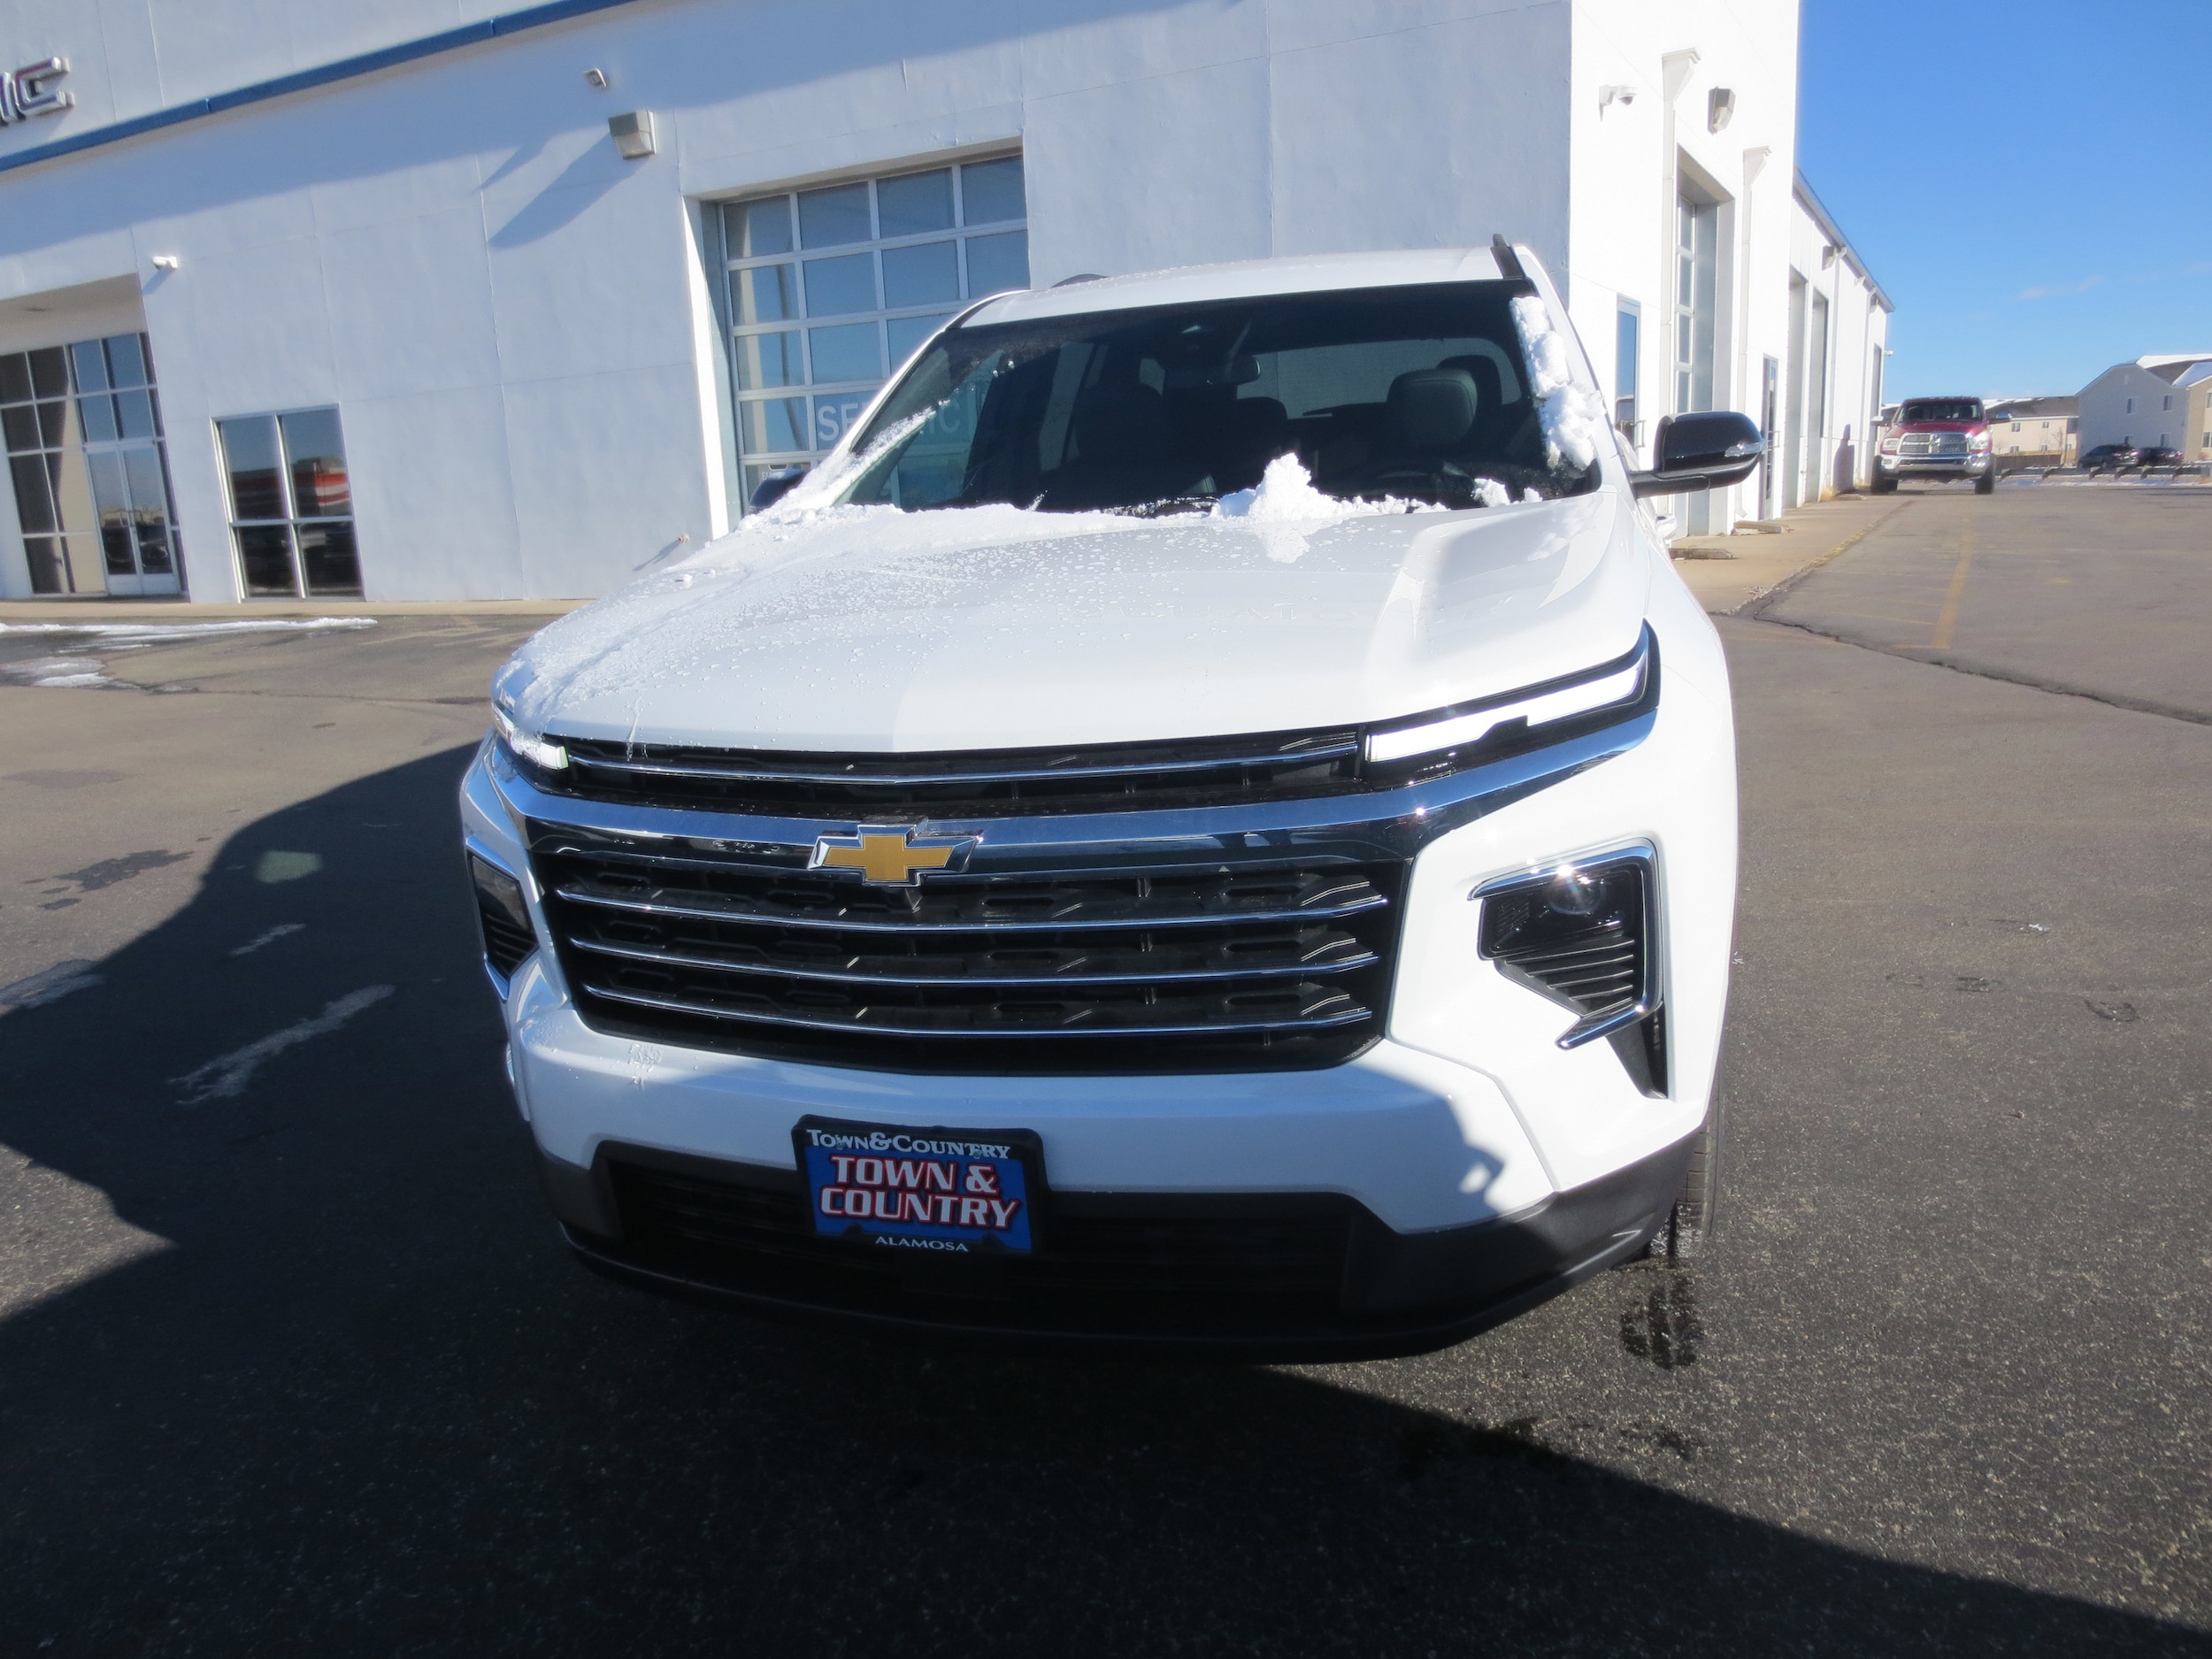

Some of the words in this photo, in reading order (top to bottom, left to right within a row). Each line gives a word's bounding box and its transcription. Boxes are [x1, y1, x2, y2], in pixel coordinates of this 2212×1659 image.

[830, 1154, 956, 1191] TOWN
[965, 1164, 1000, 1195] &
[820, 1186, 1019, 1229] COUNTRY
[875, 1236, 969, 1253] ALAMOSA
